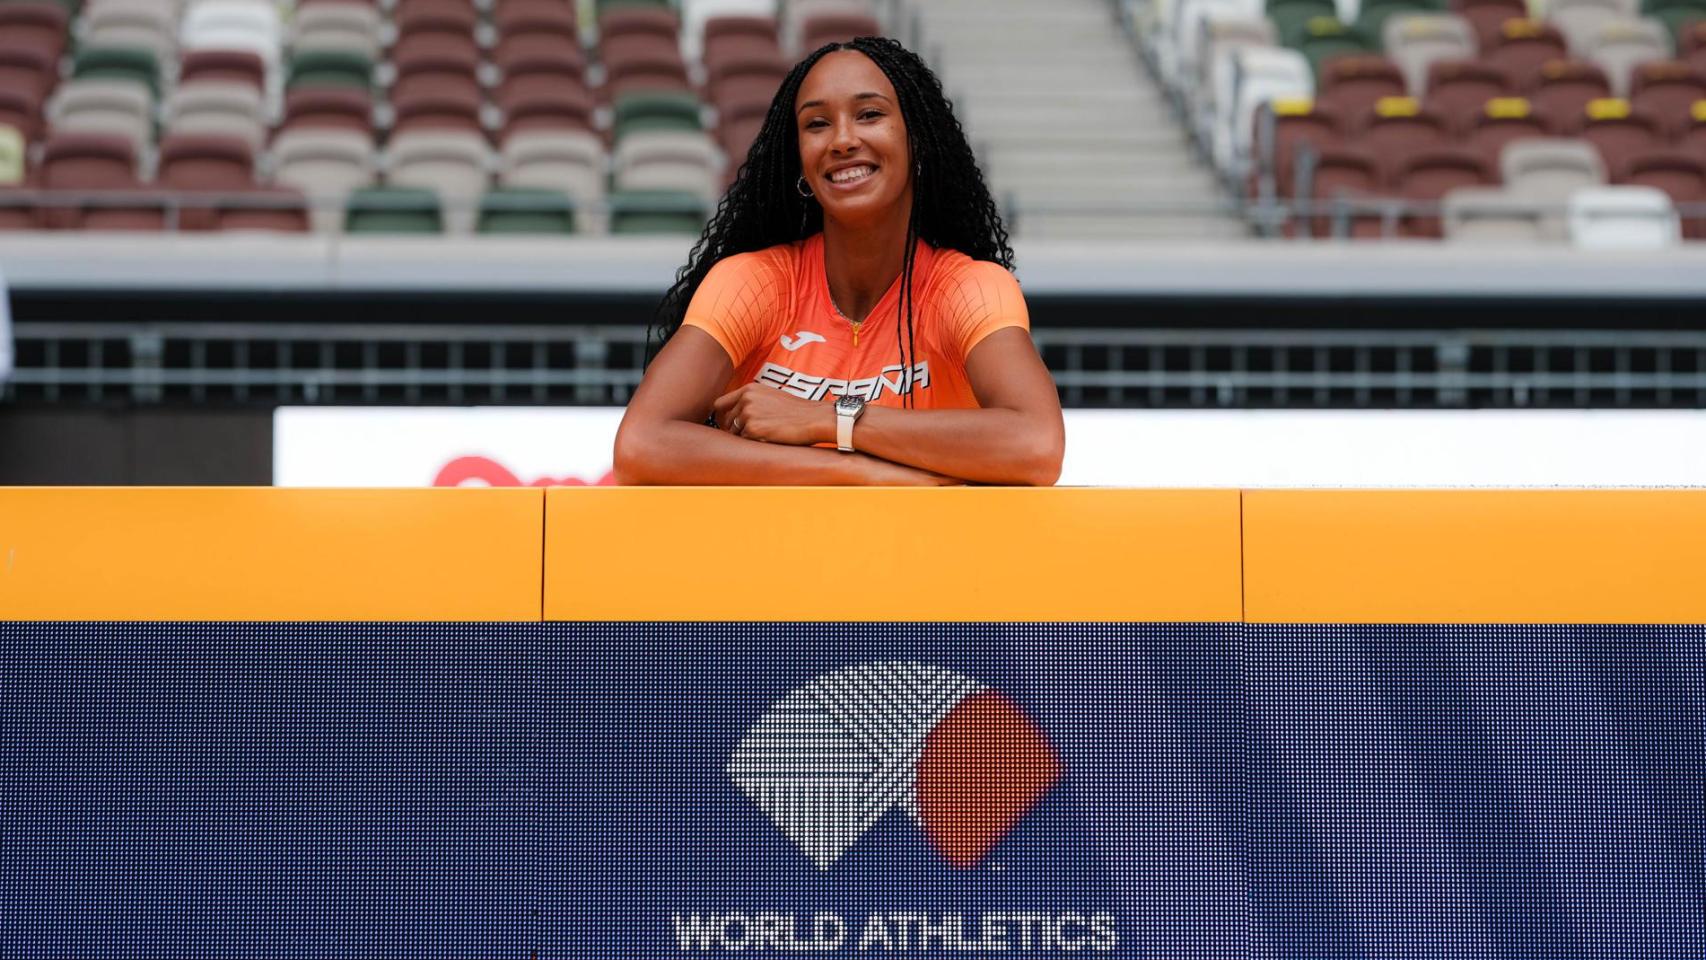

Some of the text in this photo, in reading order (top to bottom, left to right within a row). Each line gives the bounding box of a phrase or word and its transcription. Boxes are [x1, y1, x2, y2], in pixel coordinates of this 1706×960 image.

[753, 360, 931, 402] ESPAÑA
[673, 911, 1119, 951] WORLD ATHLETICS
